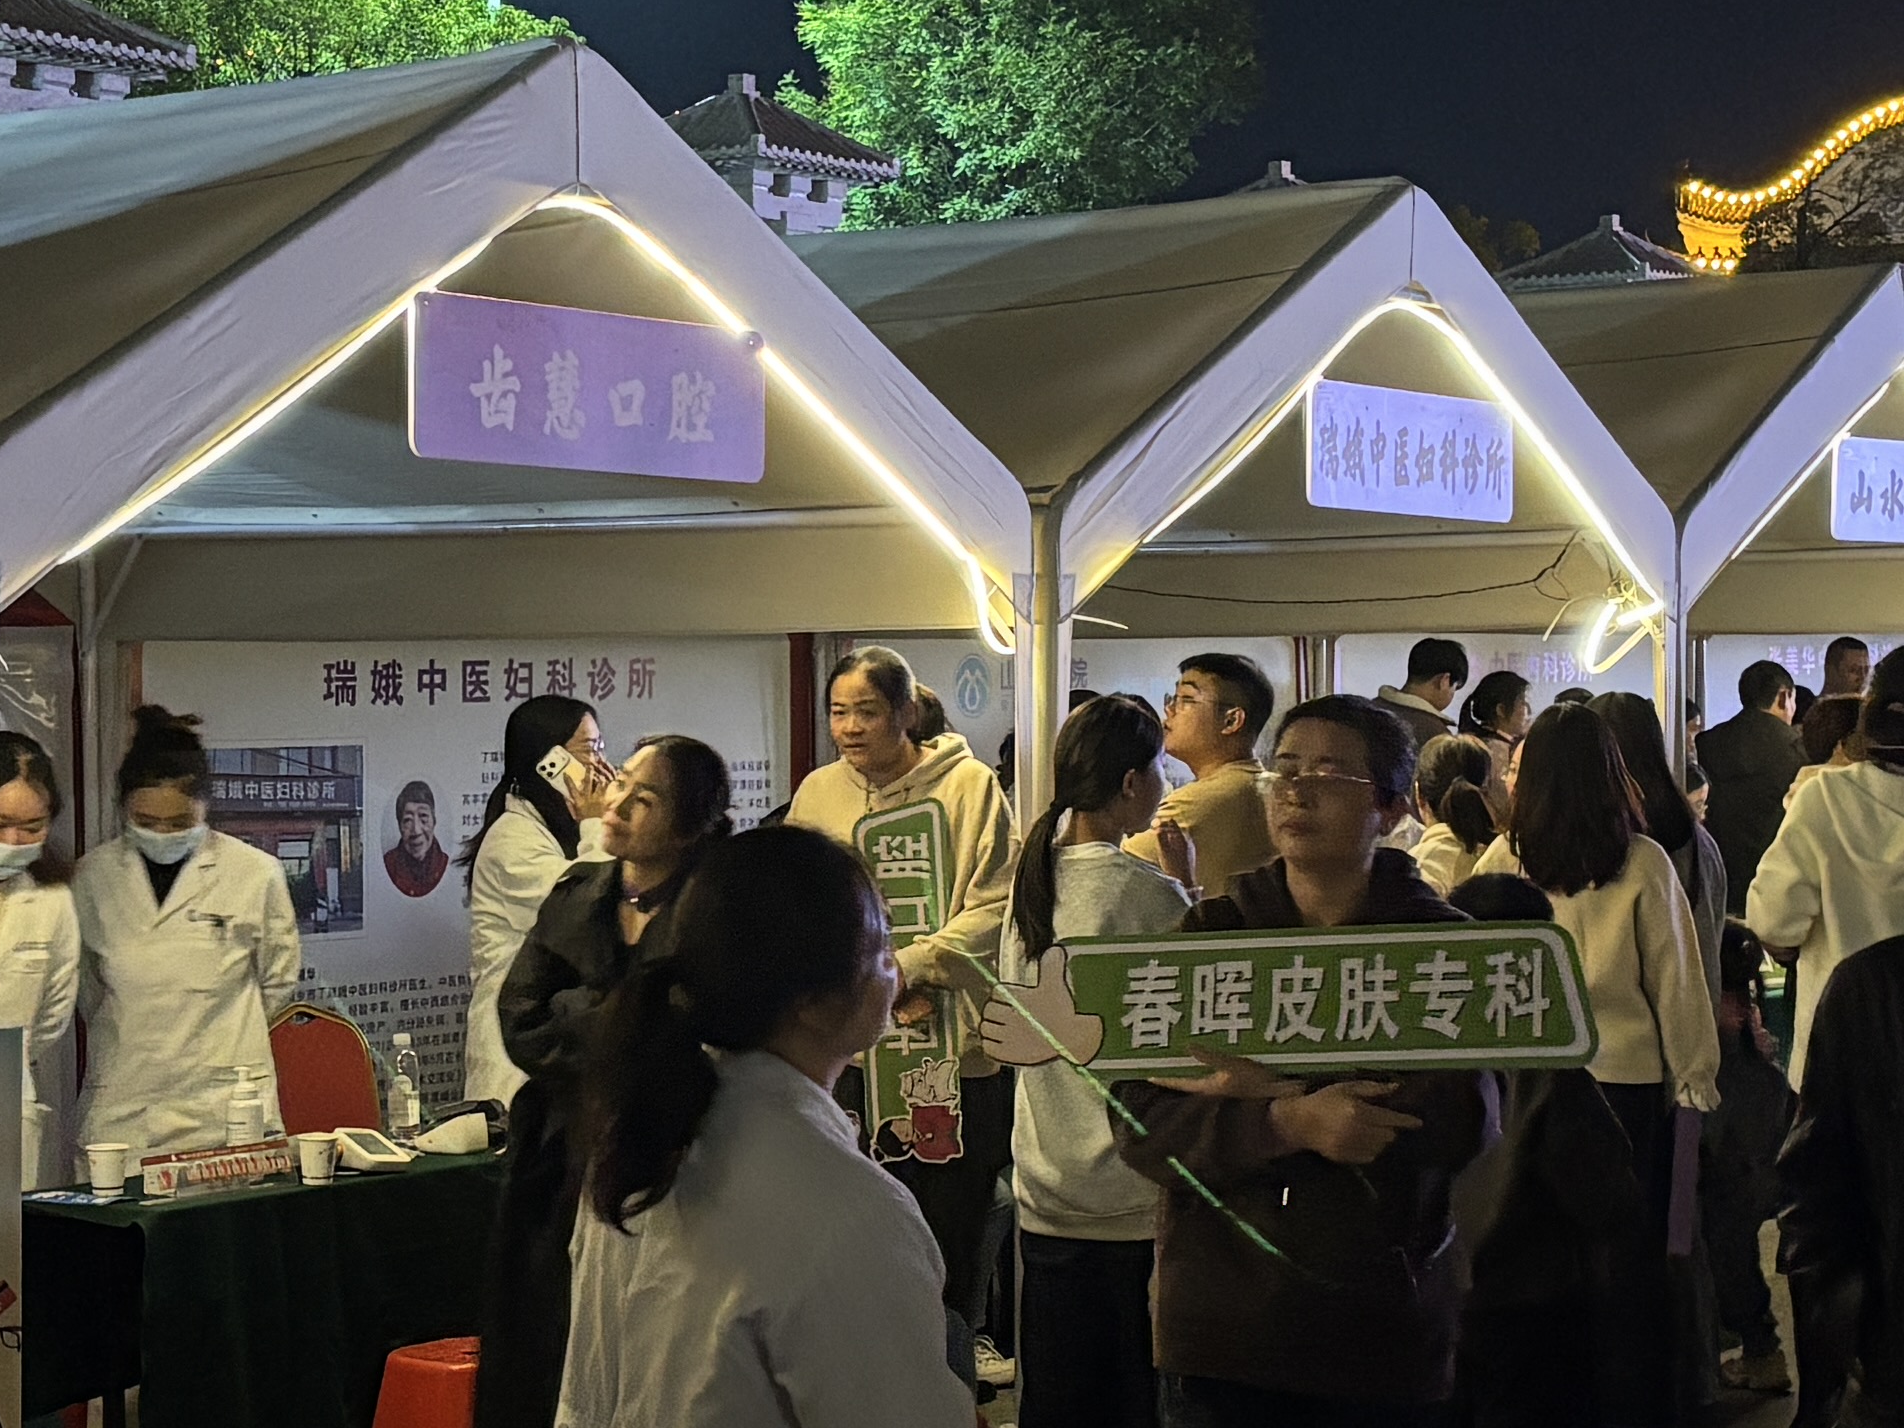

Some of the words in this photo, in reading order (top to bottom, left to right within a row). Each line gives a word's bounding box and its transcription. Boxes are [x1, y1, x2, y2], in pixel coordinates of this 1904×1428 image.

[469, 345, 715, 442] 齿慧口腔
[1319, 415, 1505, 500] 瑞娥中医妇科诊所
[323, 656, 658, 707] 瑞娥中医妇科诊所
[1120, 948, 1553, 1051] 春晖皮肤专科
